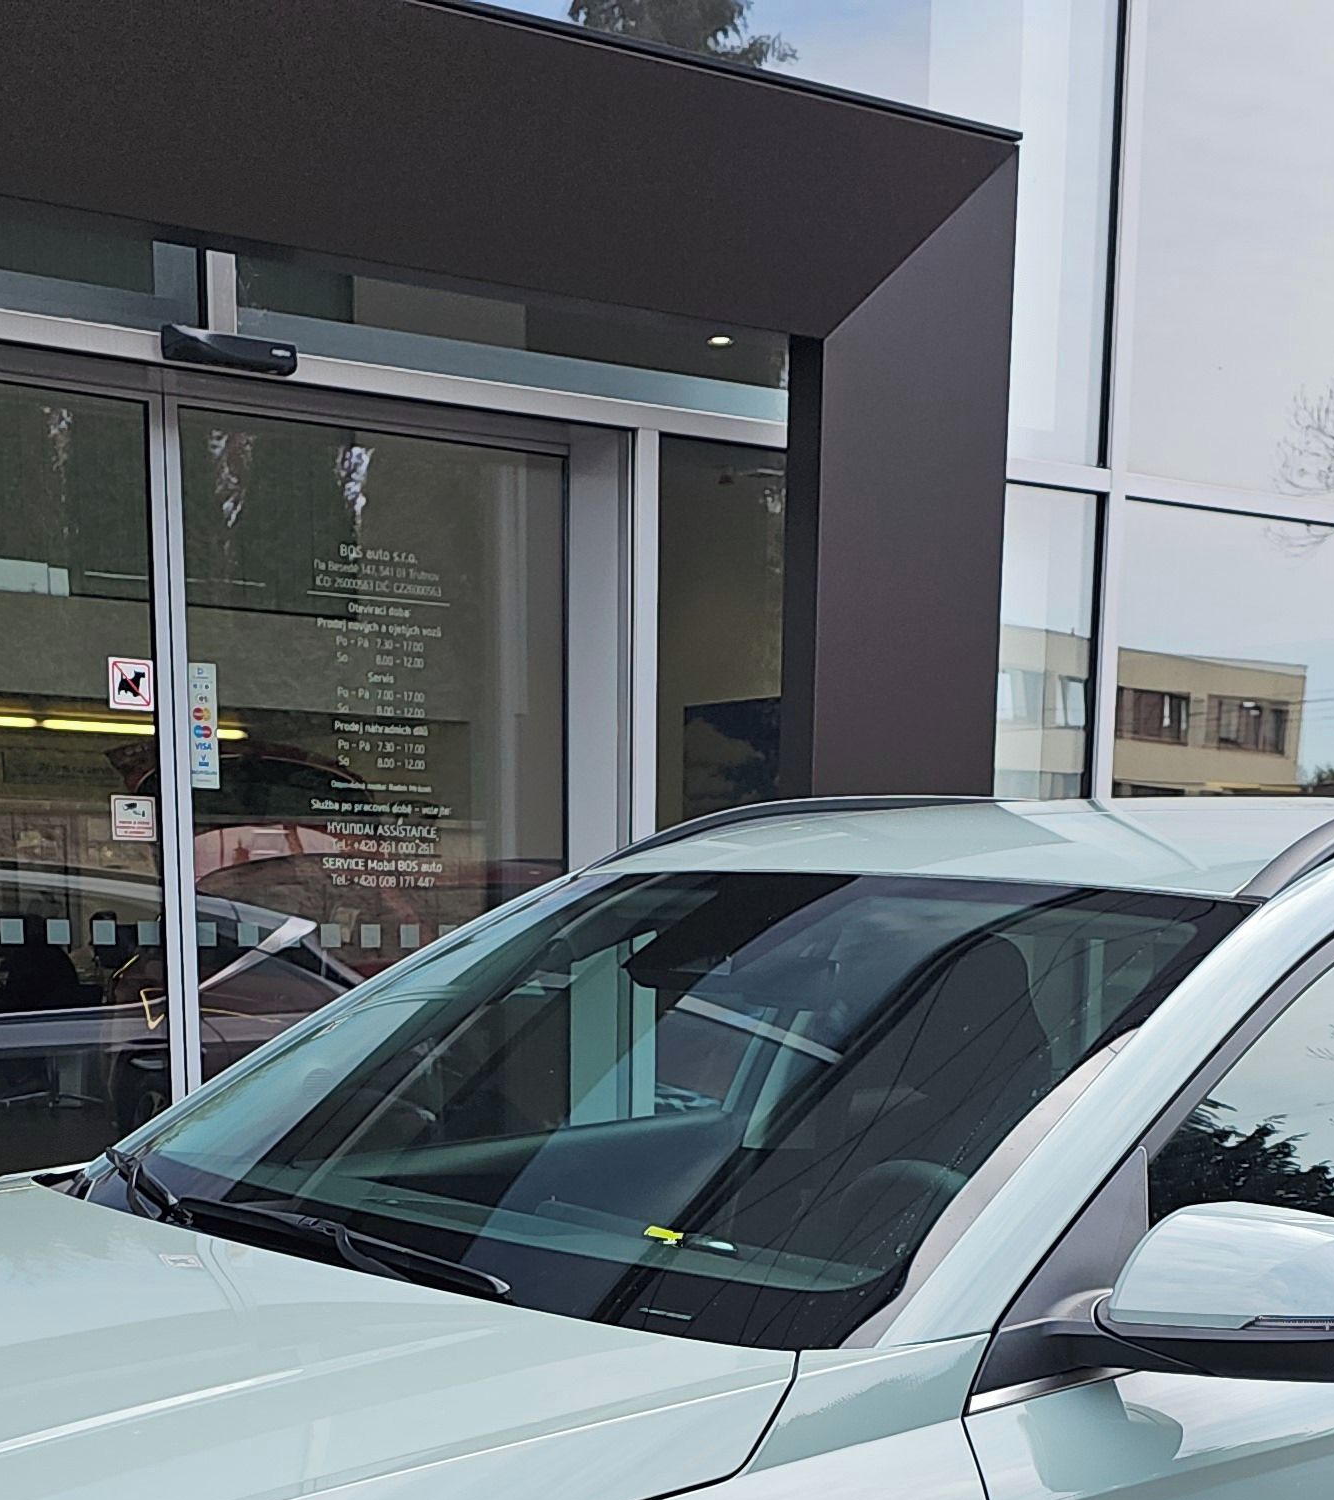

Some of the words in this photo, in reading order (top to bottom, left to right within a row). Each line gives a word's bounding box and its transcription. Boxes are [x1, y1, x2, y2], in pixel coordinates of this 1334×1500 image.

[339, 543, 363, 558] BOS
[366, 549, 390, 560] auto
[393, 551, 417, 563] s.r.o.
[317, 617, 347, 632] Prodej
[367, 672, 395, 684] Servis
[334, 720, 363, 735] Prodej
[195, 743, 213, 751] VISA
[338, 754, 350, 766] So
[341, 802, 352, 813] po
[327, 821, 374, 836] HYUNDAI
[353, 840, 377, 851] +420
[379, 841, 396, 852] 261
[398, 842, 416, 853] 000
[322, 857, 365, 870] SERVICE
[398, 860, 419, 872] BOS
[421, 862, 443, 873] auto
[353, 874, 377, 886] +420
[399, 876, 415, 887] 171
